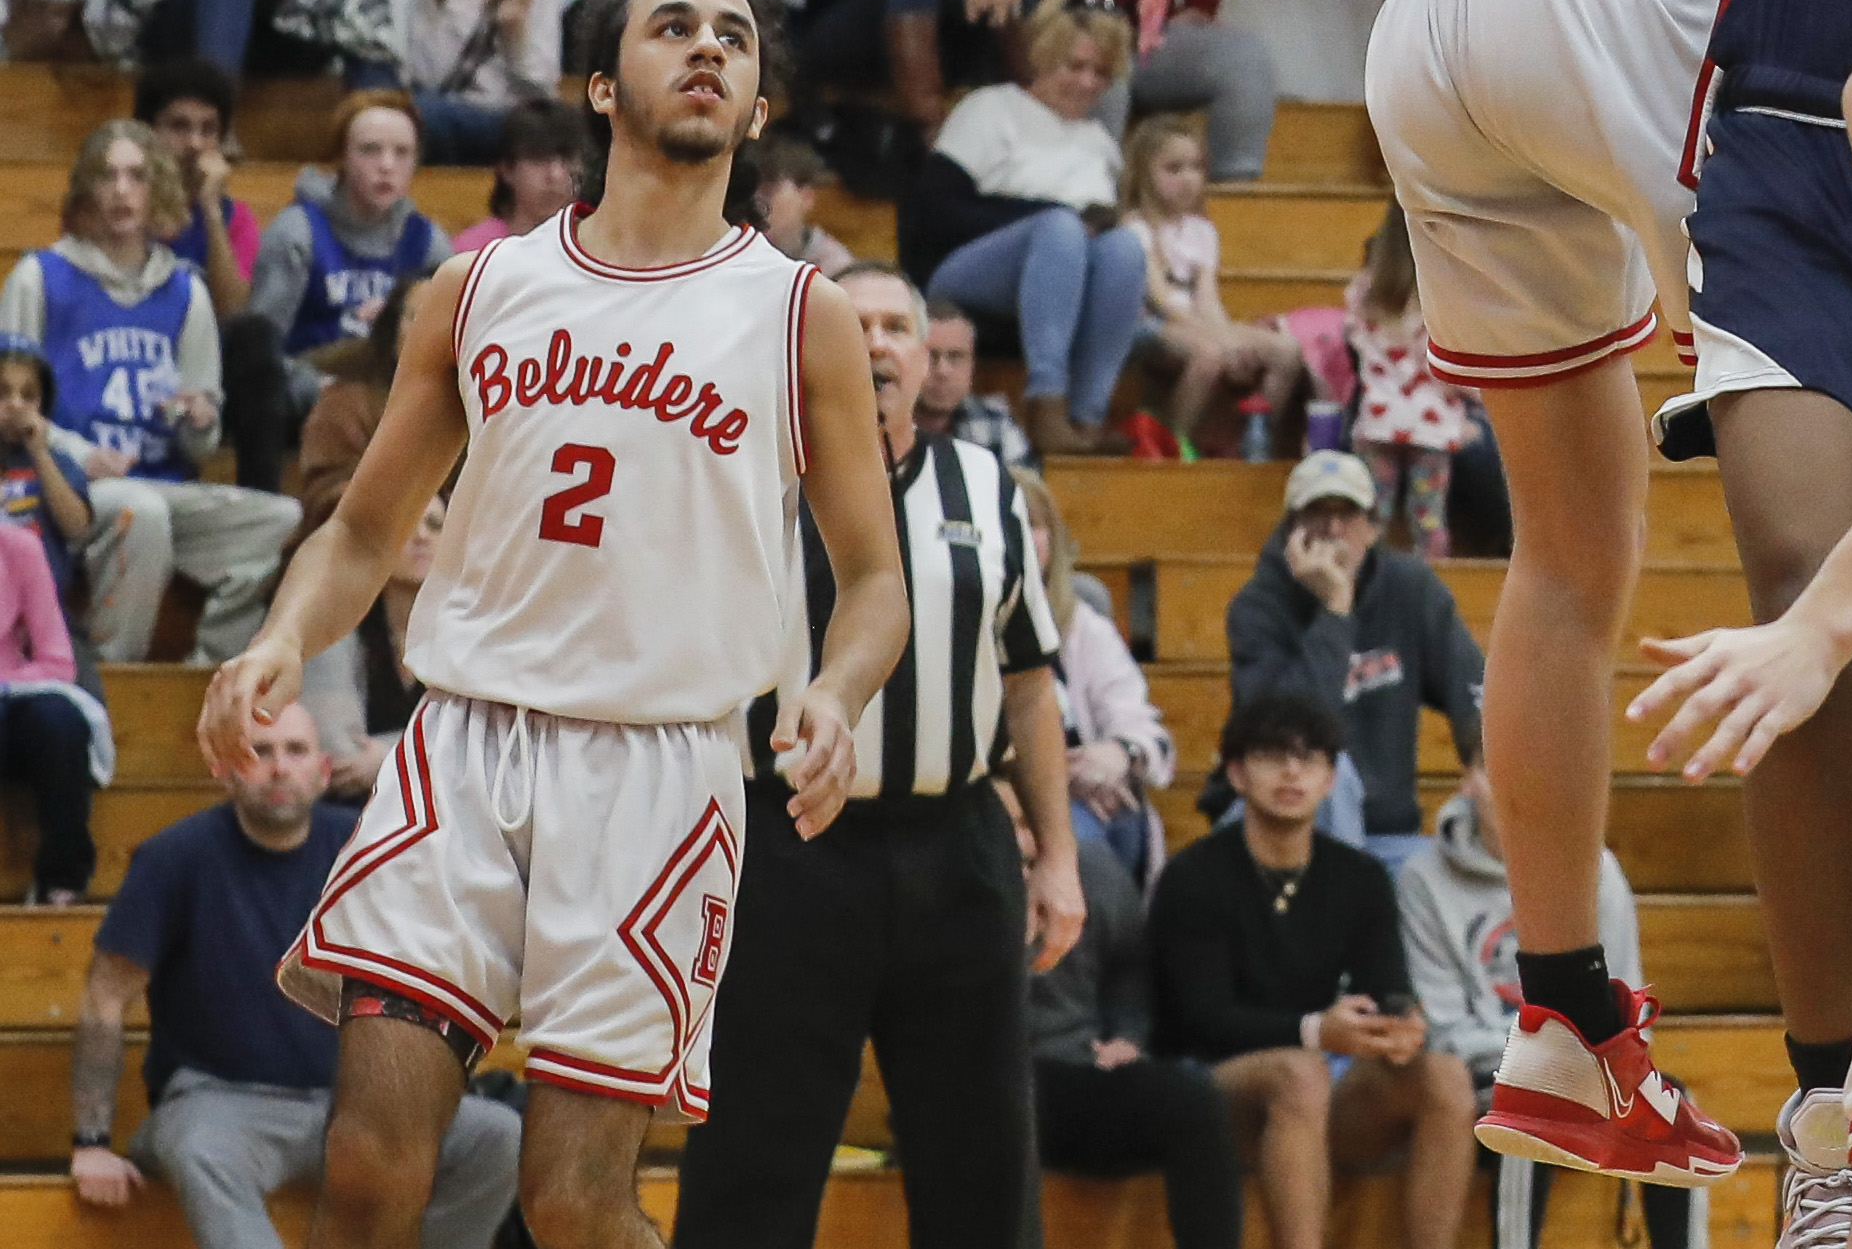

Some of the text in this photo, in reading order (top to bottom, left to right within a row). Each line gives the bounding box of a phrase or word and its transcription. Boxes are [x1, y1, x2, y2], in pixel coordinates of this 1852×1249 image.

[470, 329, 748, 455] Belvidere
[538, 442, 617, 548] 2
[691, 894, 748, 989] B
